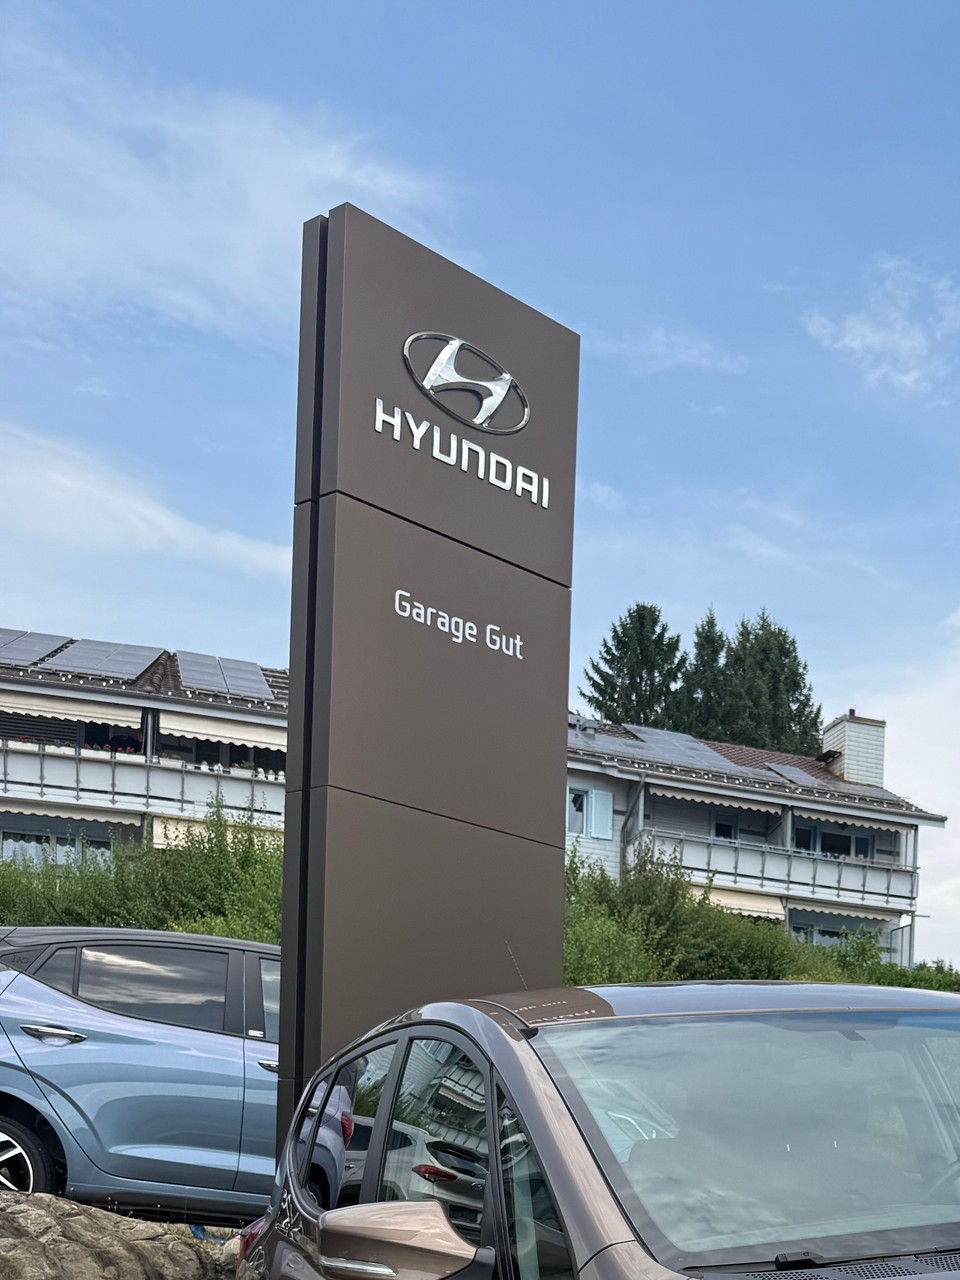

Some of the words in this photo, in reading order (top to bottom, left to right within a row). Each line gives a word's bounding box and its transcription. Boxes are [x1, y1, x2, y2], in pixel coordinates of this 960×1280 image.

[374, 397, 550, 509] HYUNDAI
[394, 589, 478, 644] Garage
[485, 623, 524, 660] Gut
